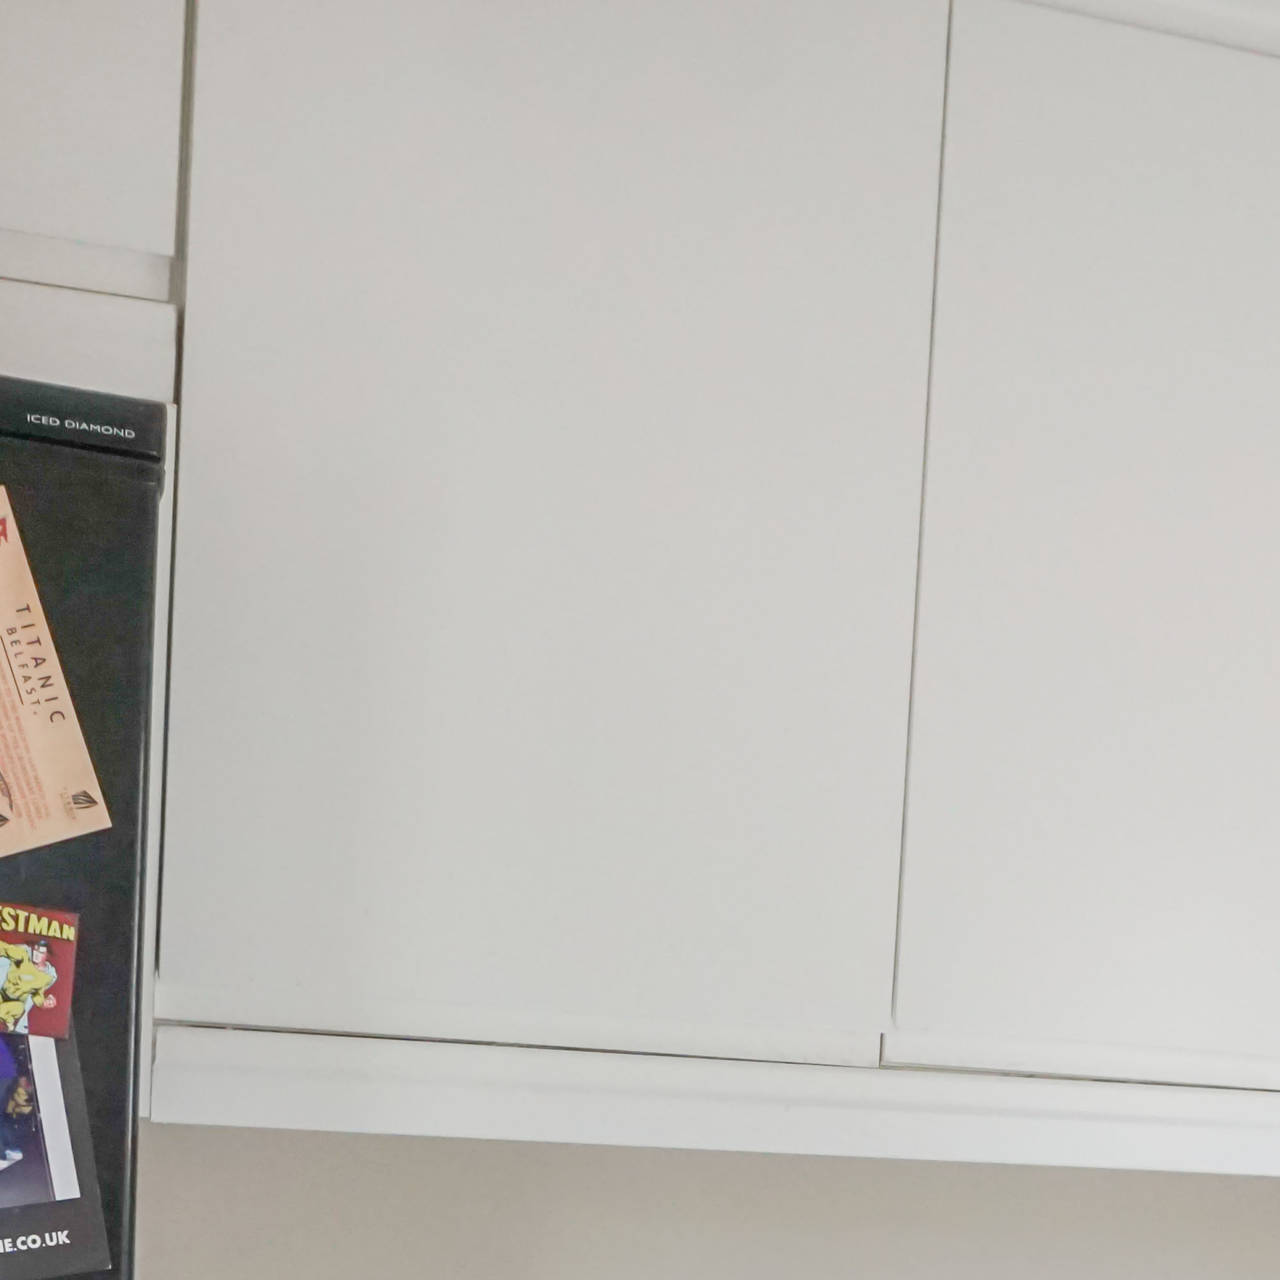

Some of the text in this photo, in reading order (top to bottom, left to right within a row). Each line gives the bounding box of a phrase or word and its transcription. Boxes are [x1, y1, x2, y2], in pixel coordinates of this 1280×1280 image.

[26, 413, 137, 439] ICED DIAMOND
[15, 603, 67, 724] TITANIC
